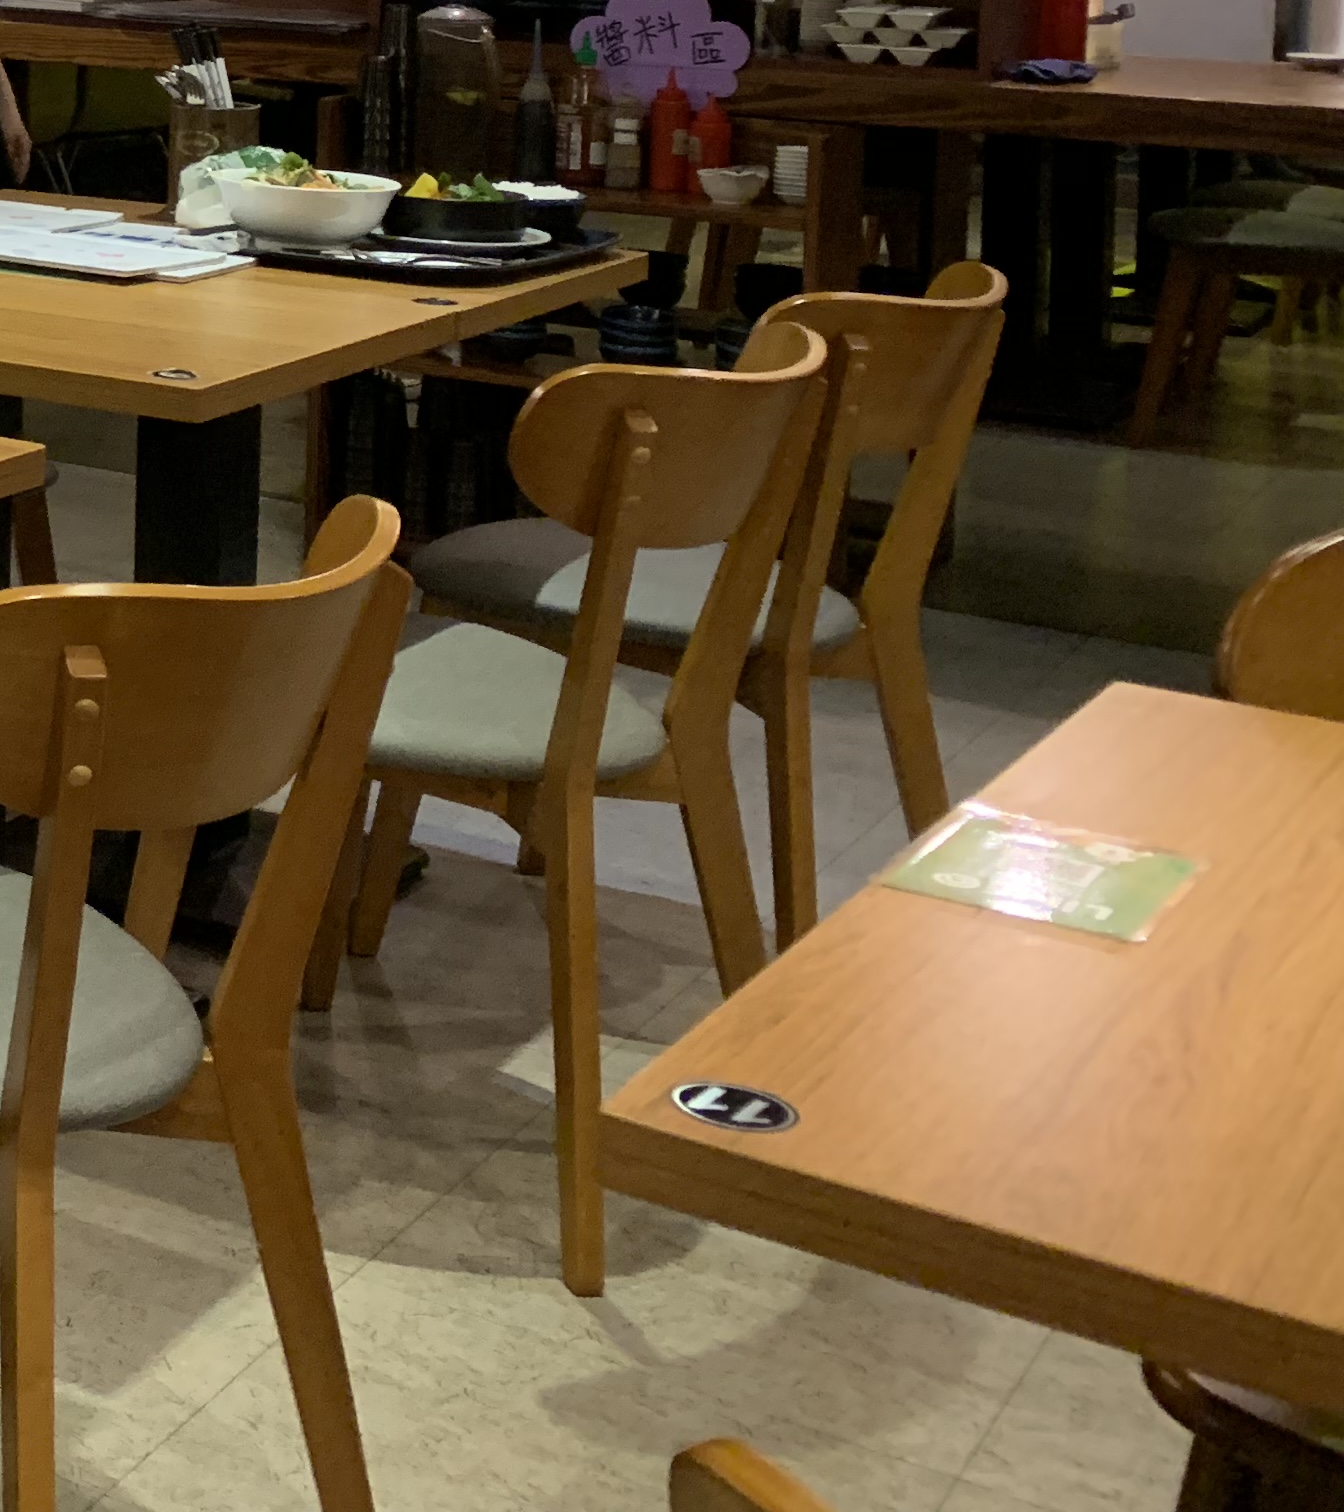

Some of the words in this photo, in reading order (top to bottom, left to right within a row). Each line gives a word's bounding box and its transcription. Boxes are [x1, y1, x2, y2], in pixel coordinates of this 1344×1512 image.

[595, 10, 727, 67] 醬料區
[686, 1086, 771, 1124] 11
